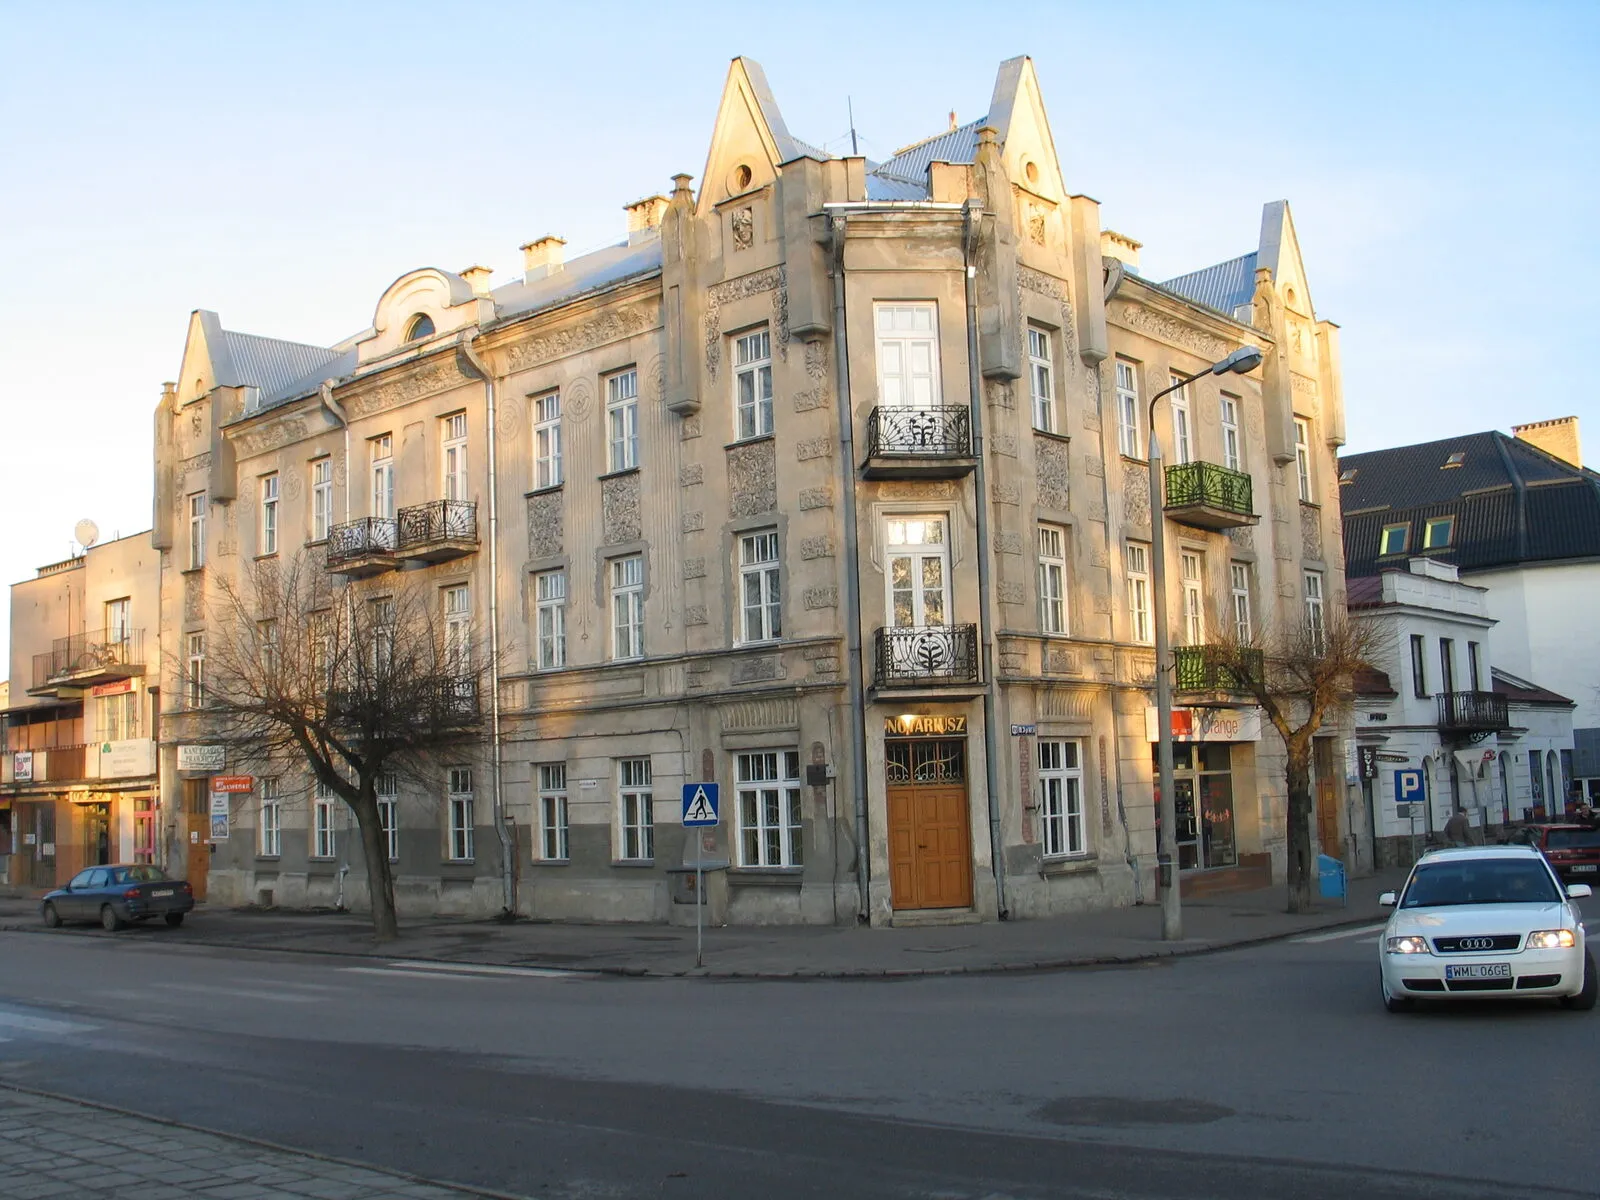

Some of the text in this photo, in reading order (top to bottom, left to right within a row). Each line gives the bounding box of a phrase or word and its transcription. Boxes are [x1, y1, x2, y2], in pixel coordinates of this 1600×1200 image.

[887, 717, 965, 734] NOTARIUSZ
[1201, 716, 1239, 738] Orange
[1401, 772, 1419, 798] P
[1454, 965, 1508, 977] WML 06GE
